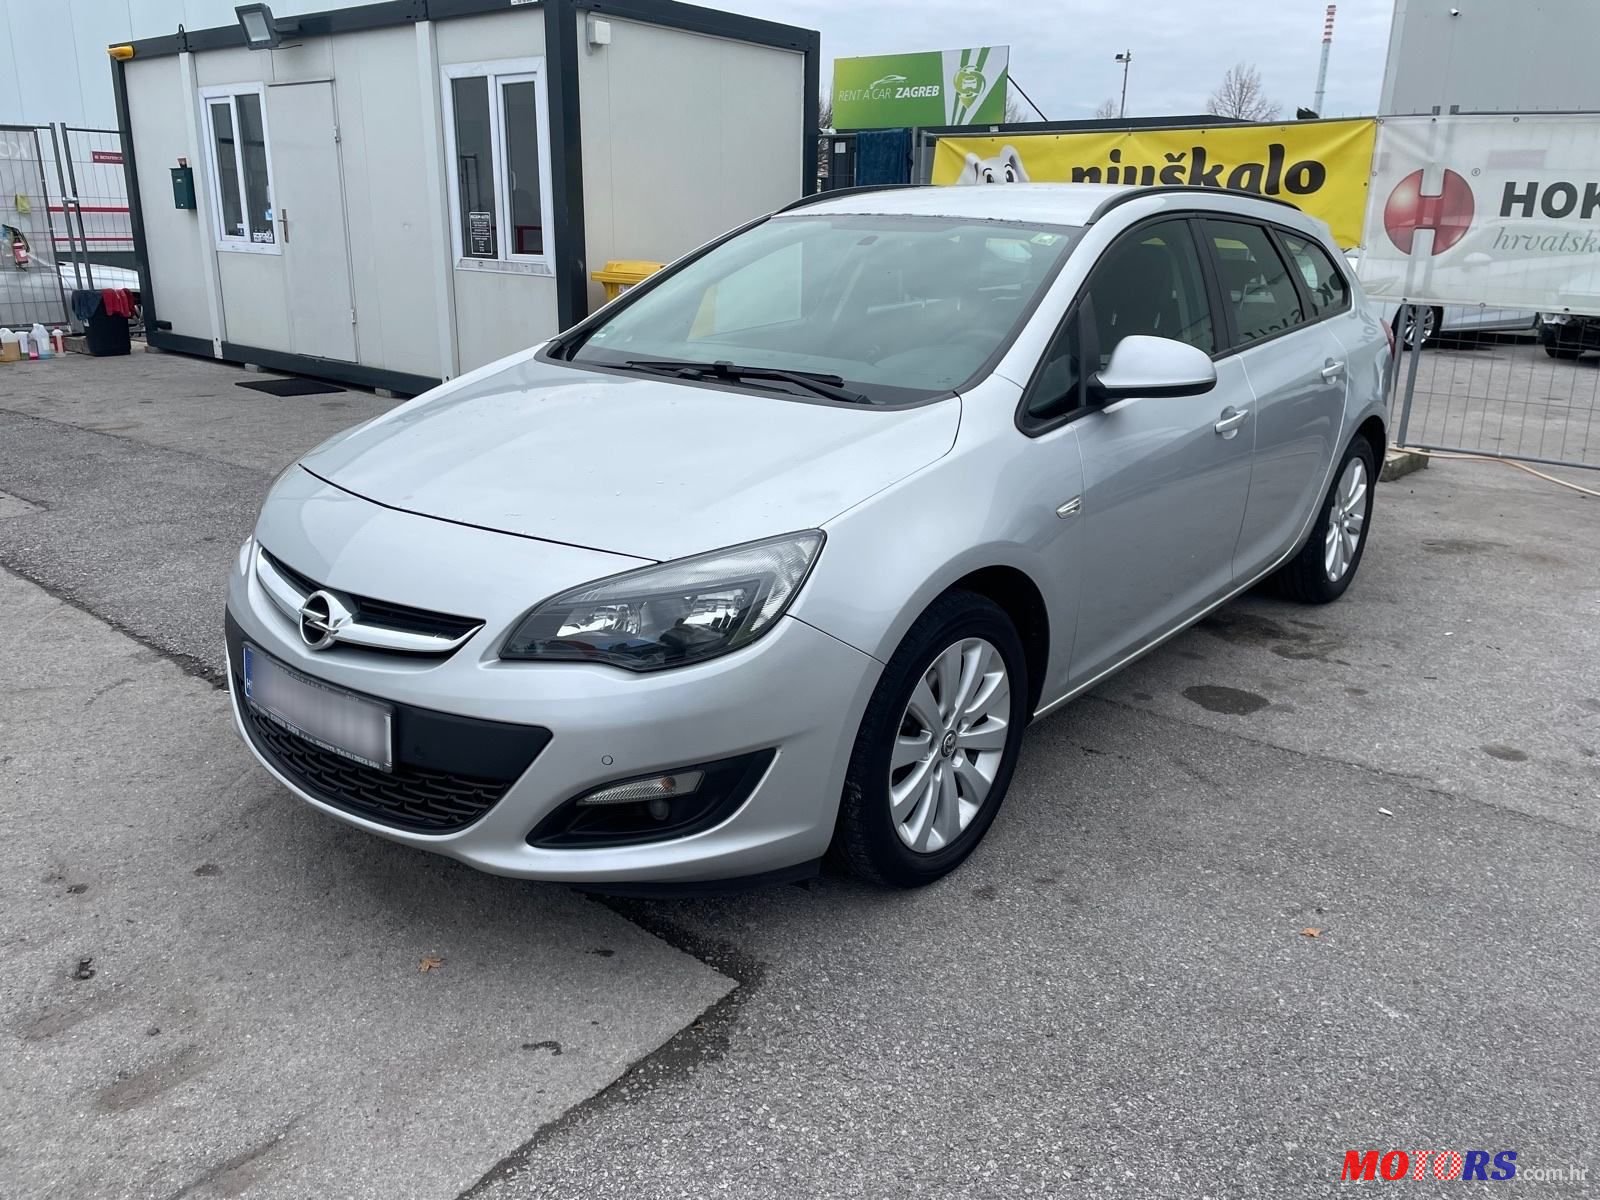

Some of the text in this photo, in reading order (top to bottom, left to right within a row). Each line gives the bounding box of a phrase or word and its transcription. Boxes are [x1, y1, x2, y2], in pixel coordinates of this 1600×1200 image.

[838, 90, 862, 101] RENT
[871, 88, 892, 100] CAR
[895, 85, 940, 99] ZAGREB
[1493, 227, 1600, 254] hrvatsk
